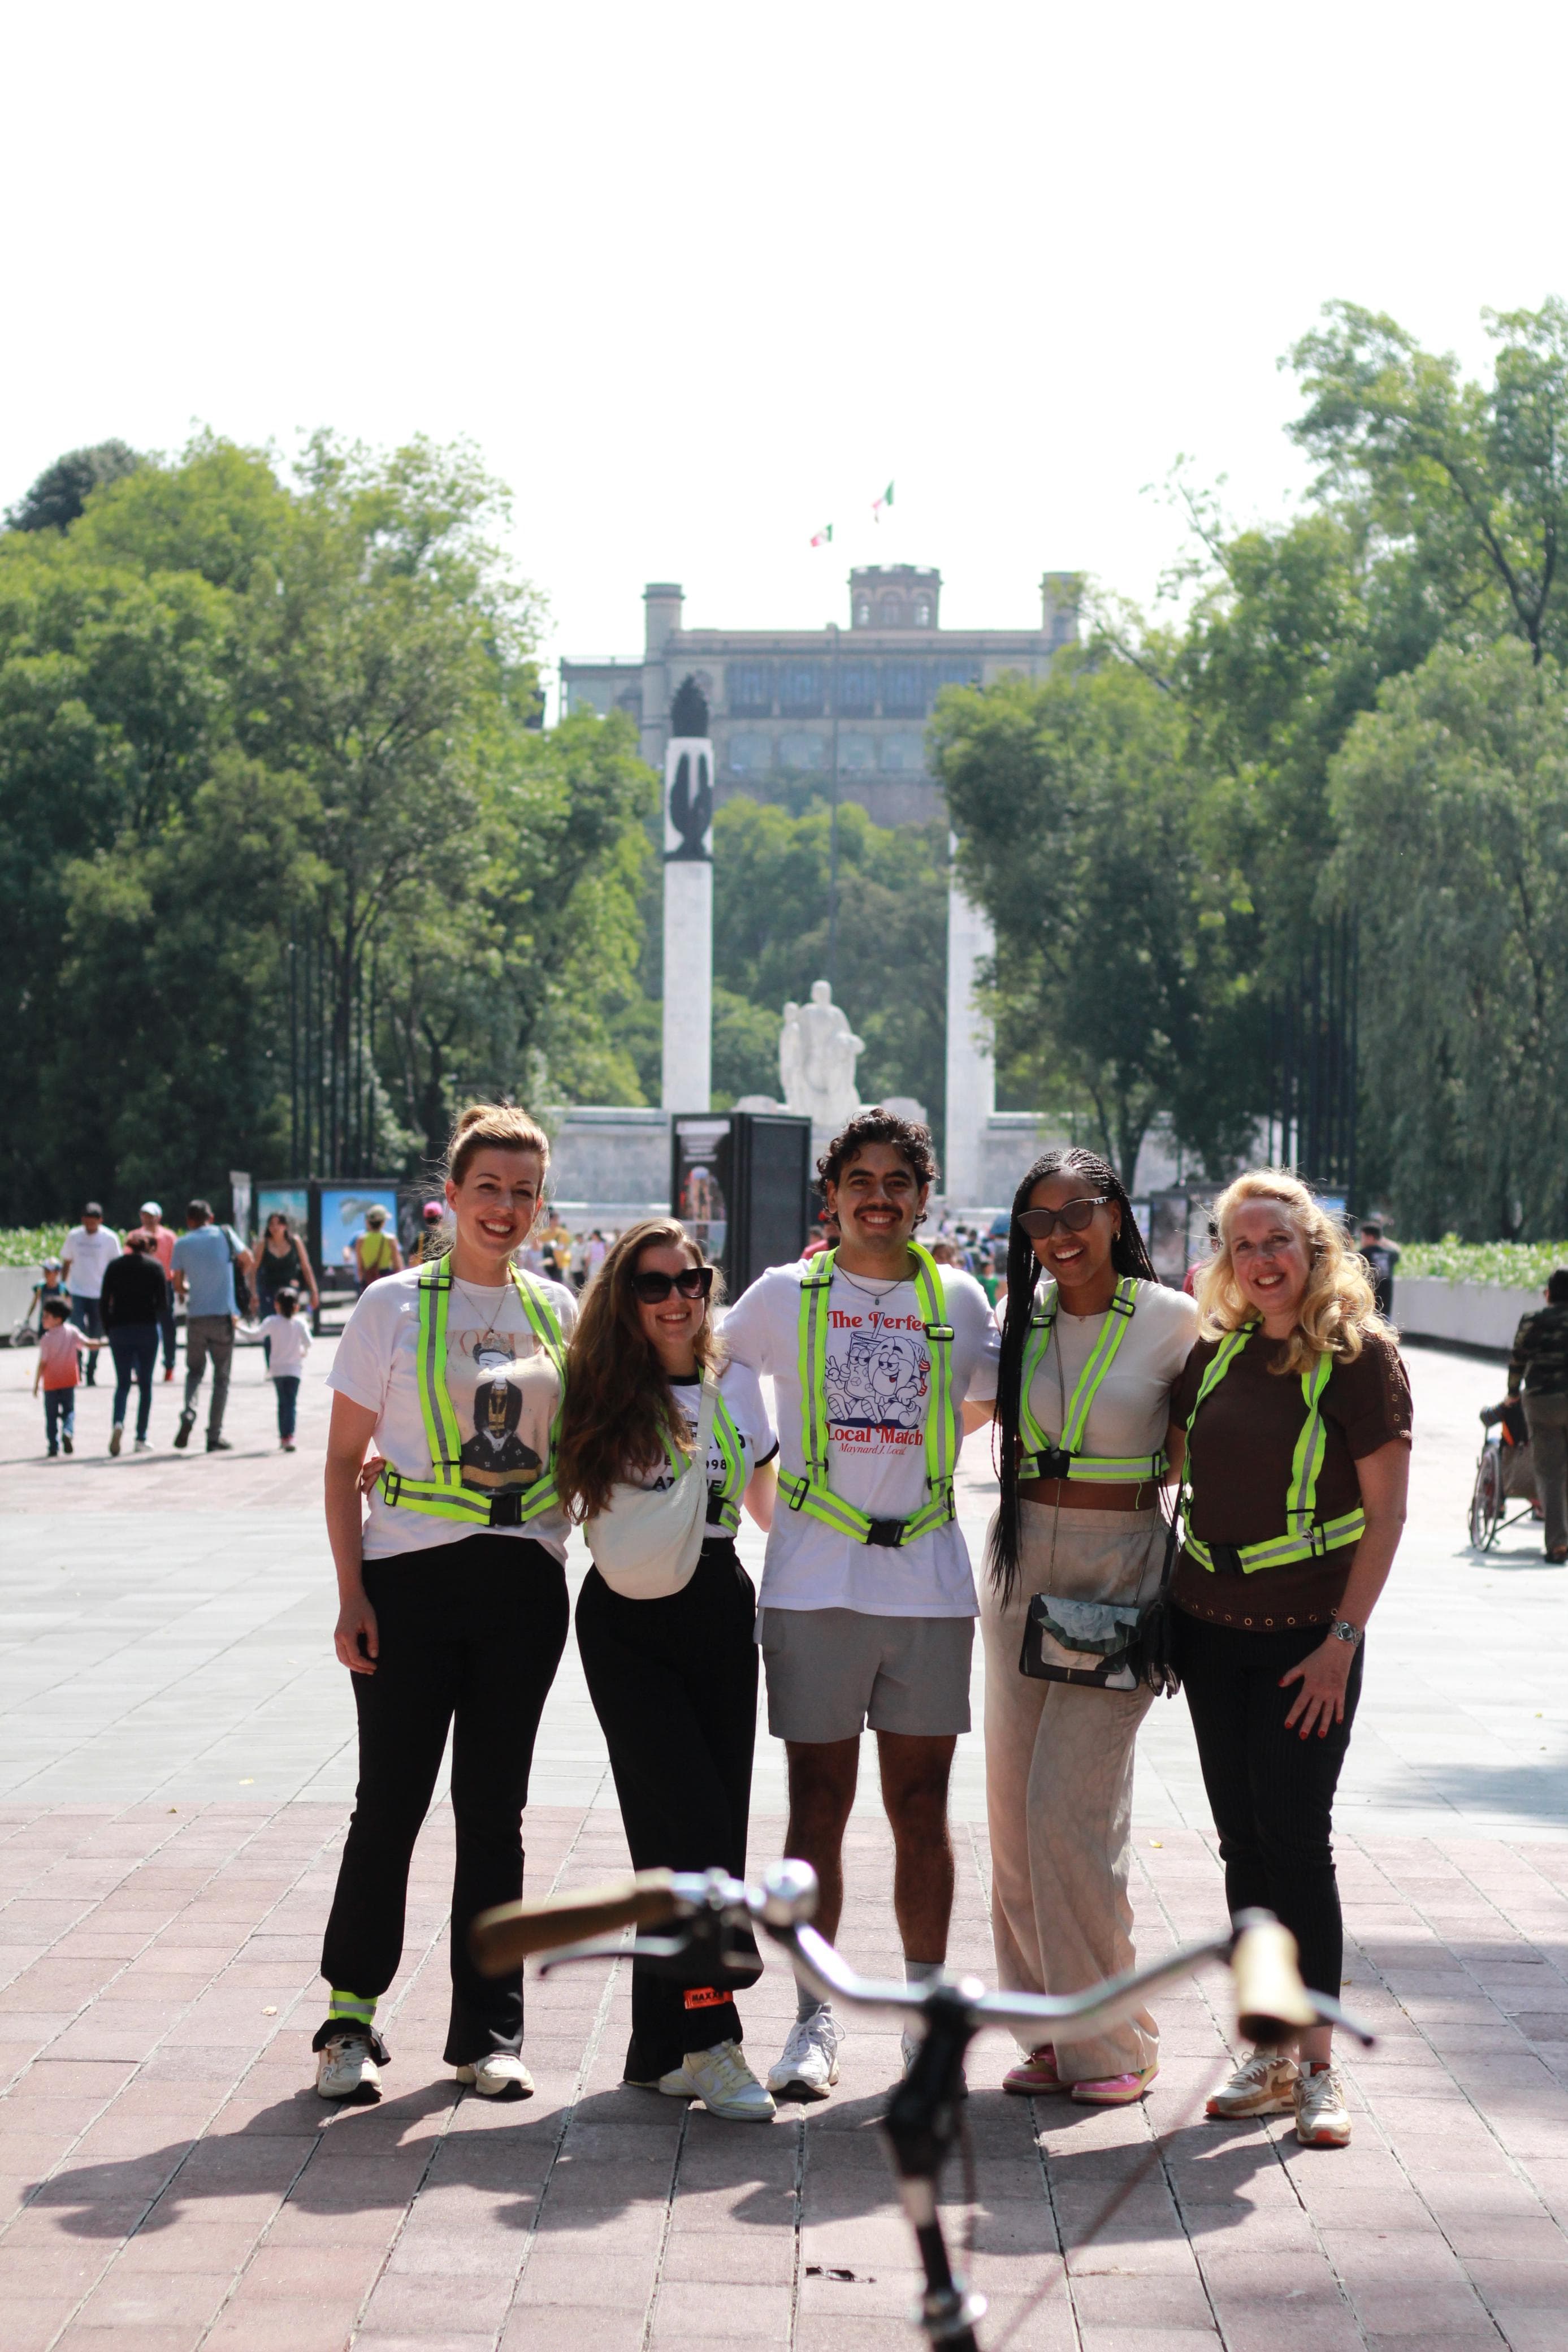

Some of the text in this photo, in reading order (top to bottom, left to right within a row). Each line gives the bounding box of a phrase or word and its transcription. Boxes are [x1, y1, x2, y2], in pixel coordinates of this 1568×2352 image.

[827, 1311, 926, 1331] The Perfe
[825, 1422, 923, 1446] Local Match
[839, 1443, 878, 1455] Maynard
